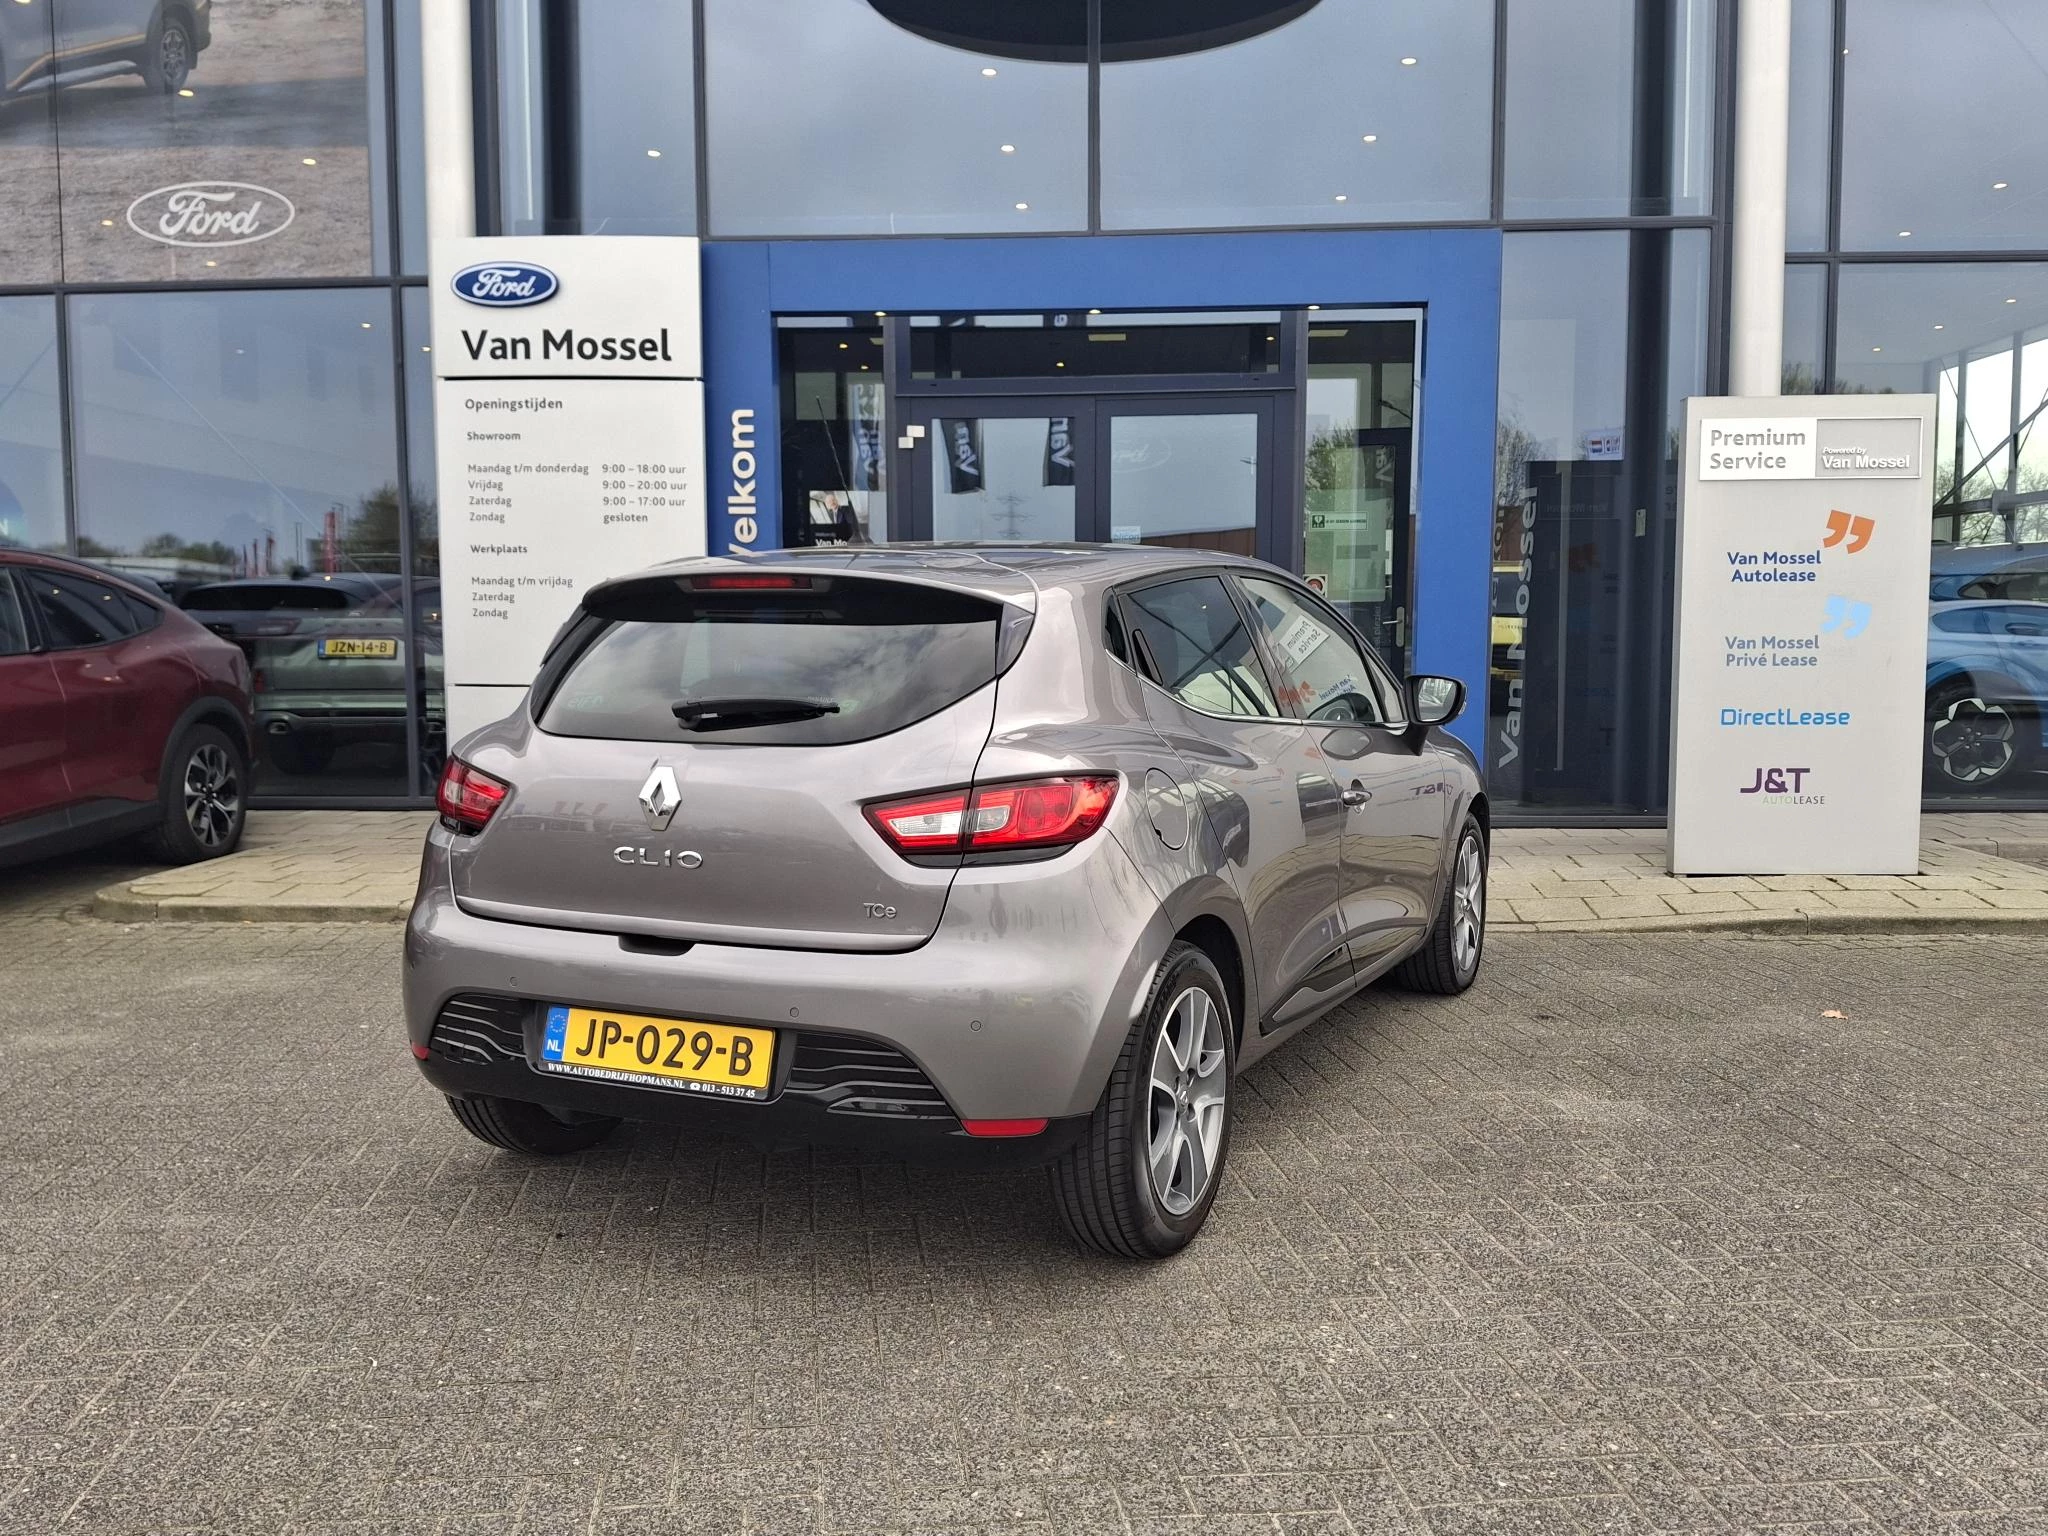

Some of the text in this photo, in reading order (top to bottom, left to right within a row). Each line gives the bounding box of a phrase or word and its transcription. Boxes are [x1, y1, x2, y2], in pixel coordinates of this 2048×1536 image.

[160, 191, 262, 235] Ford
[472, 268, 536, 298] Ford
[461, 328, 672, 361] Van Mossel
[465, 398, 563, 413] Openingstijden
[466, 431, 521, 441] Showroom
[1711, 429, 1806, 446] Premium
[1857, 447, 1867, 455] by
[1710, 452, 1787, 469] Service
[1823, 455, 1910, 468] Van Mossel
[468, 464, 589, 475] Maandag t/m donderdag
[602, 464, 626, 473] 9:00
[637, 464, 666, 474] 18:00
[669, 465, 687, 474] uur
[468, 480, 503, 491] Vrijdag
[602, 480, 626, 490] 9:00
[637, 480, 667, 490] 20:00
[670, 482, 687, 490] uur
[469, 496, 512, 507] Zaterdag
[602, 497, 627, 506] 9:00
[638, 497, 666, 506] 17:00
[669, 498, 686, 506] uur
[469, 512, 505, 524] Zondag
[603, 513, 648, 524] gesloten
[470, 544, 528, 556] Werkplaats
[1727, 551, 1821, 564] Van Mossel
[471, 576, 573, 588] Maandag t/m vrijdag
[1731, 569, 1816, 582] Autolease
[472, 592, 515, 604] Zaterdag
[472, 608, 508, 619] Zondag
[331, 642, 387, 653] JZN-14-B
[1725, 635, 1819, 649] Van Mossel
[1726, 653, 1817, 666] Privé Lease
[1721, 708, 1850, 725] DirectLease
[1498, 679, 1524, 768] Van
[1740, 768, 1810, 793] J&T
[1763, 796, 1825, 804] AUTOLEASE
[614, 846, 703, 869] CLIO
[864, 902, 897, 919] TCe
[546, 1019, 753, 1076] NL JP-029-B
[548, 1063, 685, 1088] WWW.AUTOBEDRIJFHOPMANS.NL
[702, 1084, 714, 1092] 013
[721, 1086, 734, 1095] 513
[736, 1087, 745, 1096] 37
[746, 1088, 755, 1098] 45
